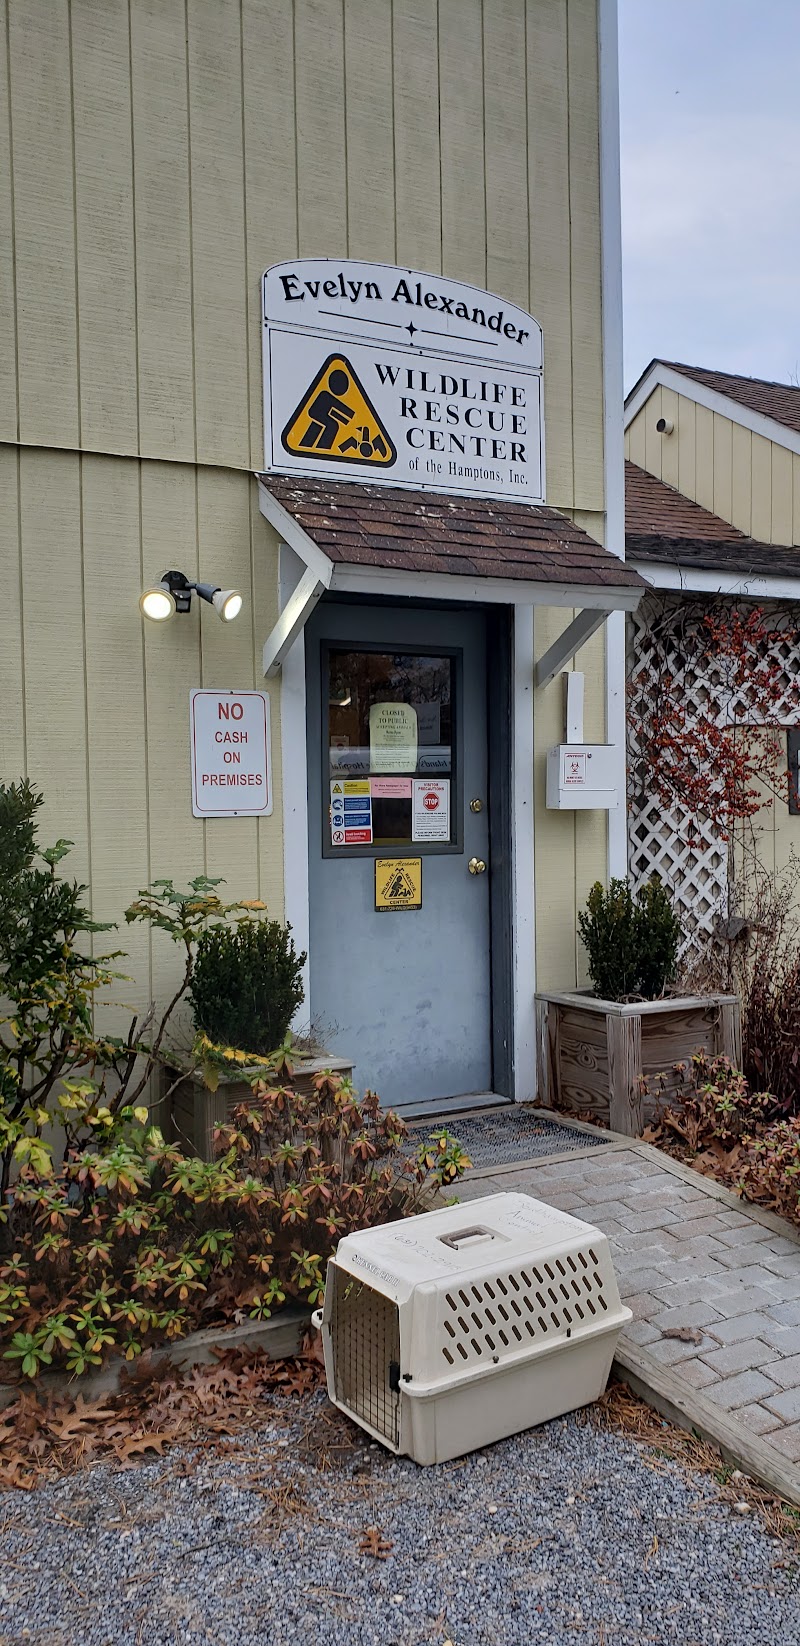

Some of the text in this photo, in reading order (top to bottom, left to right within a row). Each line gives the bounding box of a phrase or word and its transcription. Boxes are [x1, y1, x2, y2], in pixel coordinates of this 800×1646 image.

[279, 272, 529, 346] Evelyn Alexander
[375, 363, 527, 408] WILDLIFE
[399, 397, 527, 436] RESCUE
[406, 427, 527, 463] CENTER
[408, 457, 528, 485] of the Hamptons, Inc.
[218, 702, 244, 721] NO
[214, 731, 248, 744] CASH
[223, 751, 241, 764] ON
[202, 774, 263, 786] PREMISES
[424, 798, 438, 806] STOP
[377, 860, 394, 868] Evelyn
[381, 873, 395, 895] WILDLIFE
[405, 873, 416, 891] RESCUE
